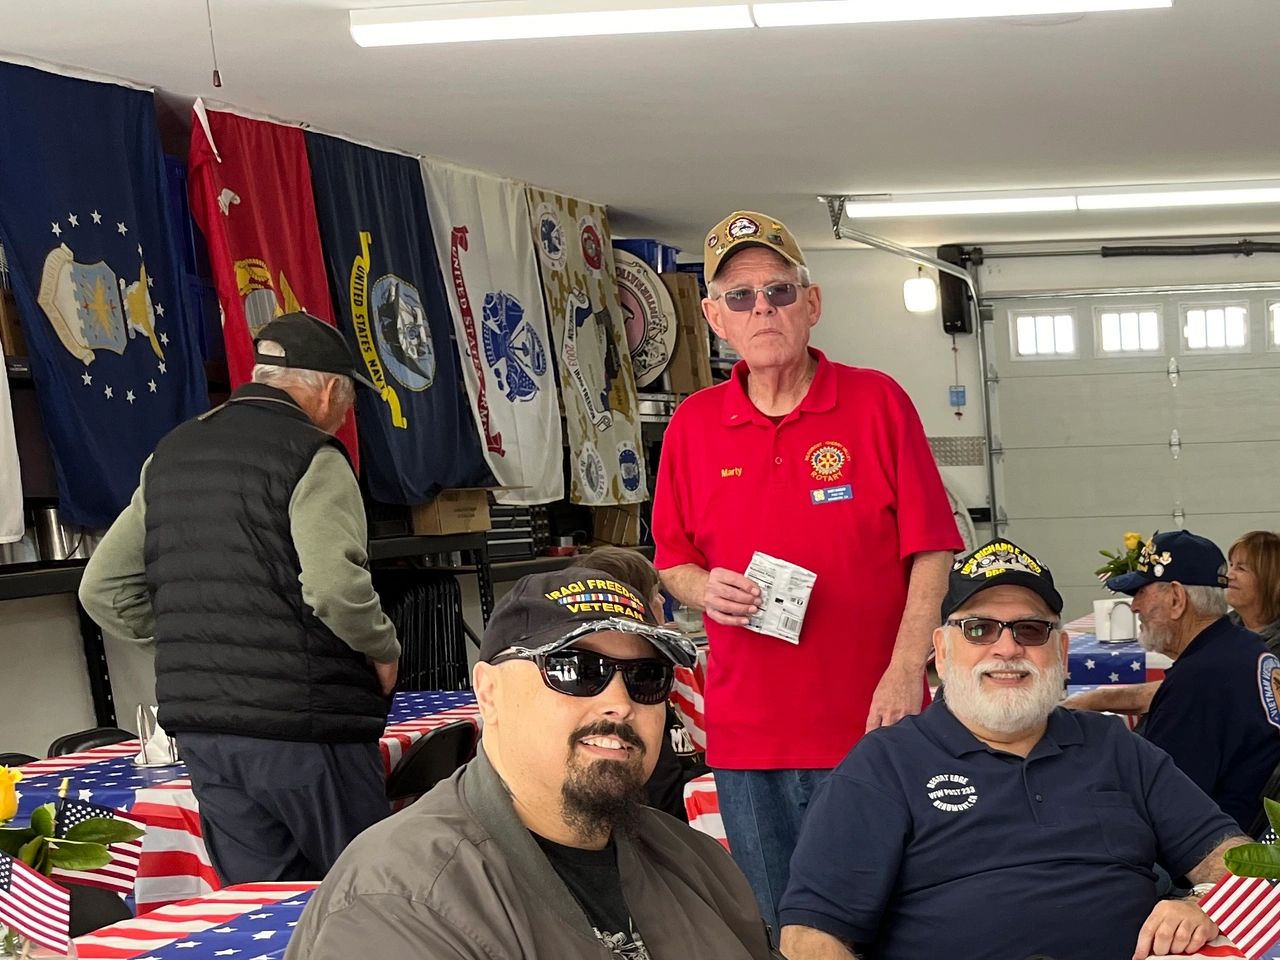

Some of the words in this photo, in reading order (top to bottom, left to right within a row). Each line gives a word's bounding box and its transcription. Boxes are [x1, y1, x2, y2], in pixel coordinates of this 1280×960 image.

[353, 264, 366, 307] UNITED
[451, 246, 468, 309] UNITED
[463, 315, 482, 382] STATES
[354, 313, 371, 353] STATES
[368, 360, 385, 390] NAVY
[564, 343, 578, 367] 2003
[582, 387, 596, 420] FREEDOM
[720, 466, 743, 478] Marty
[810, 470, 843, 482] ROTARY
[974, 542, 1014, 560] RICHARD
[545, 581, 585, 600] IRAQI
[566, 603, 644, 622] VETERAN
[1262, 680, 1278, 718] VIETNAM
[928, 789, 944, 800] VFW
[944, 789, 961, 797] POST
